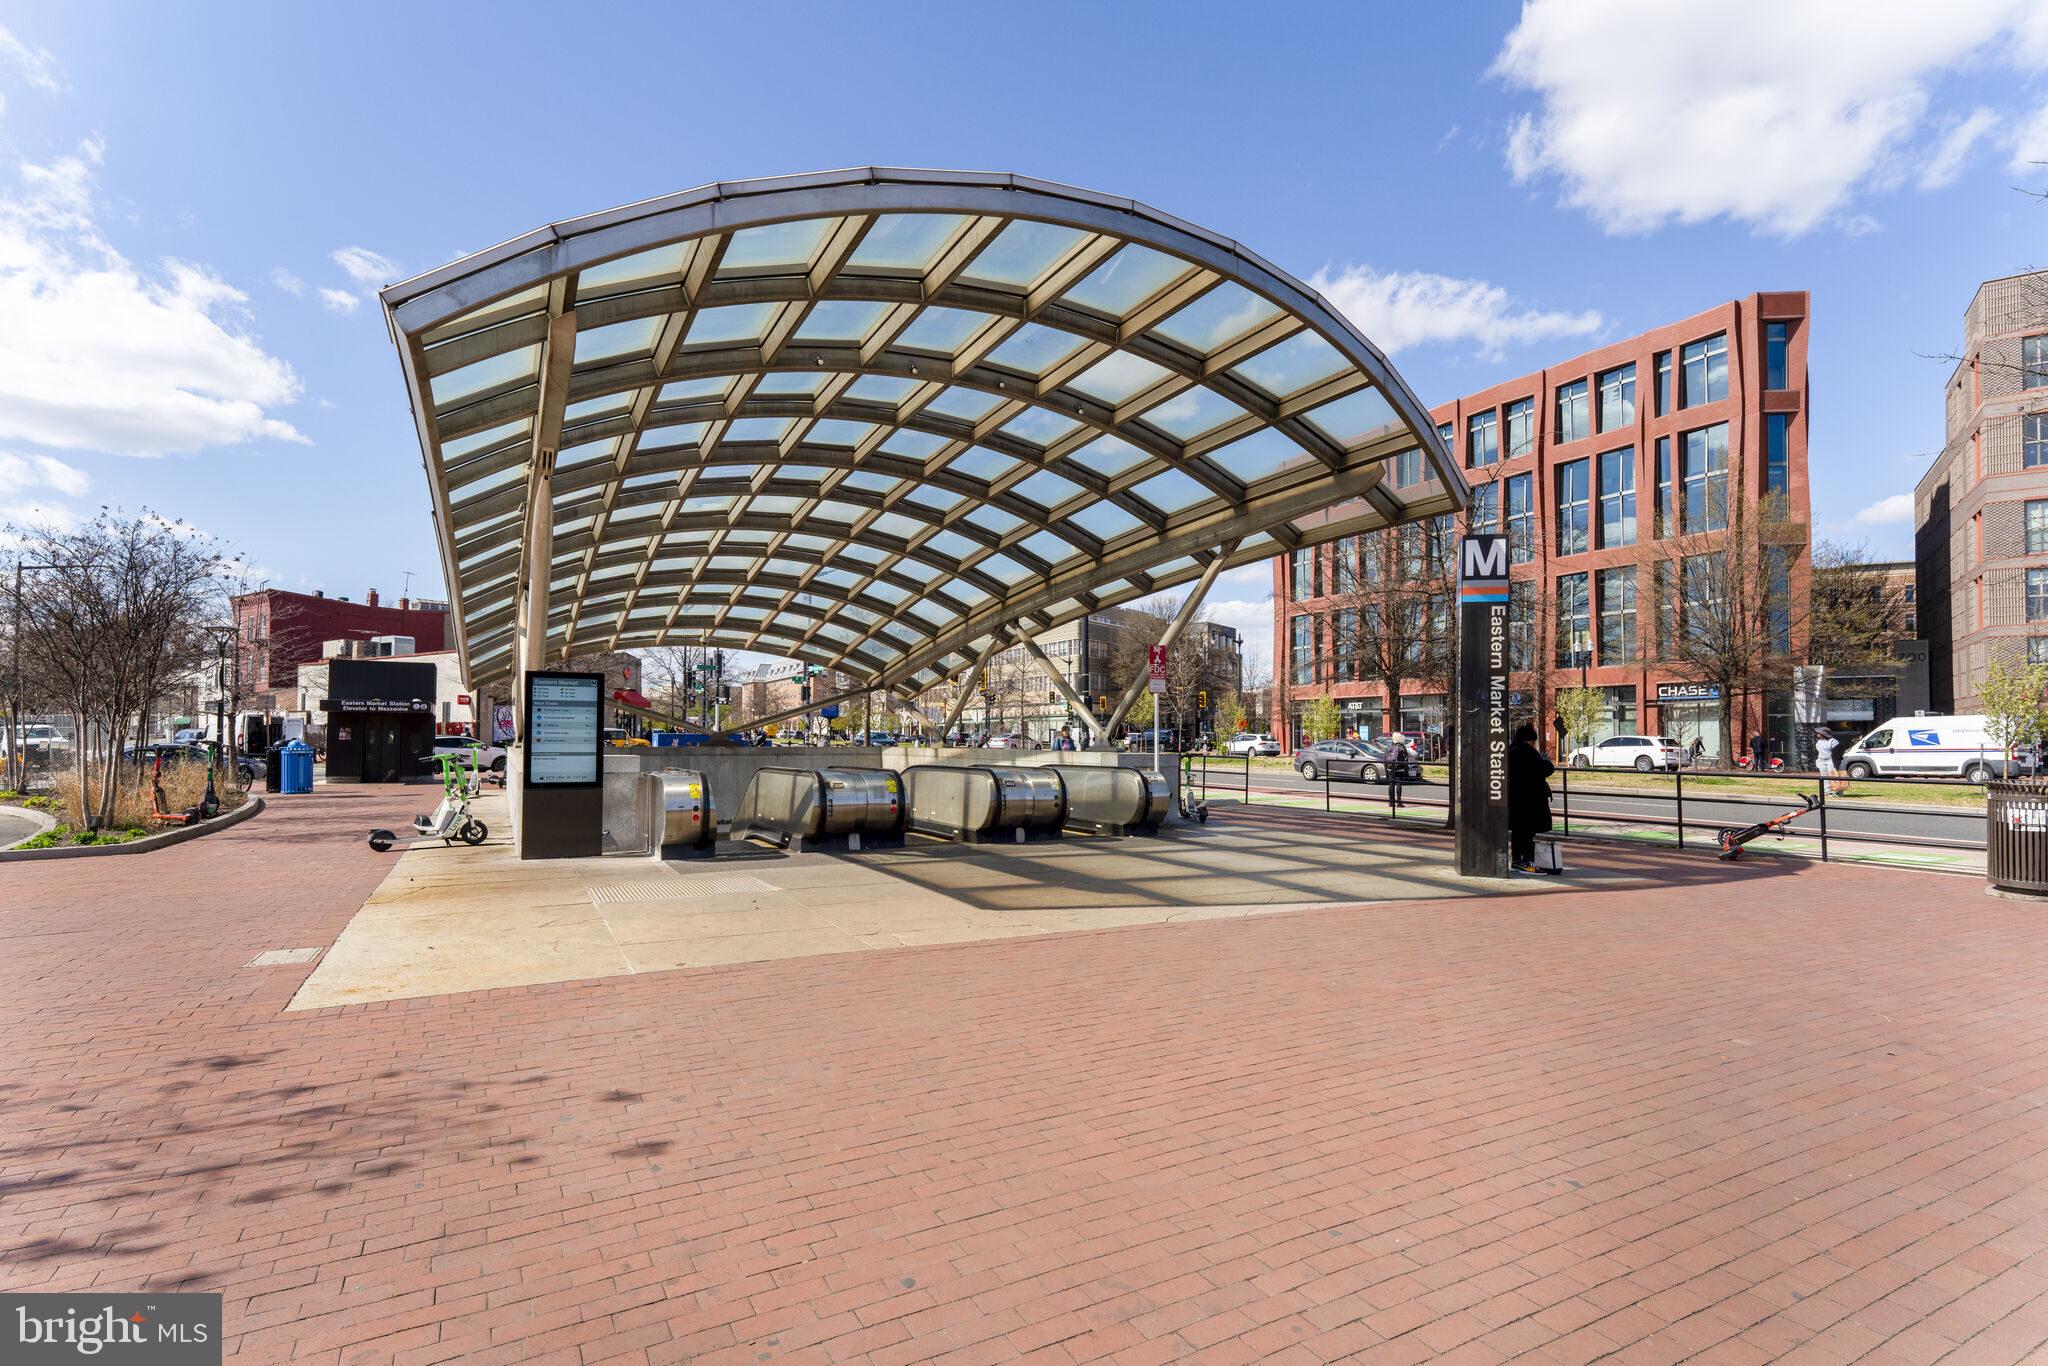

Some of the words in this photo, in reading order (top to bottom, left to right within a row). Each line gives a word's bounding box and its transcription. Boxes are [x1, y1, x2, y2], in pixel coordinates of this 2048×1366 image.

[1465, 538, 1507, 577] M
[1490, 605, 1507, 669] Eastern
[1149, 665, 1166, 674] FDC
[1347, 702, 1363, 710] AT&T
[1490, 676, 1506, 734] Market
[1658, 685, 1708, 697] CHASE
[1490, 740, 1506, 801] Station
